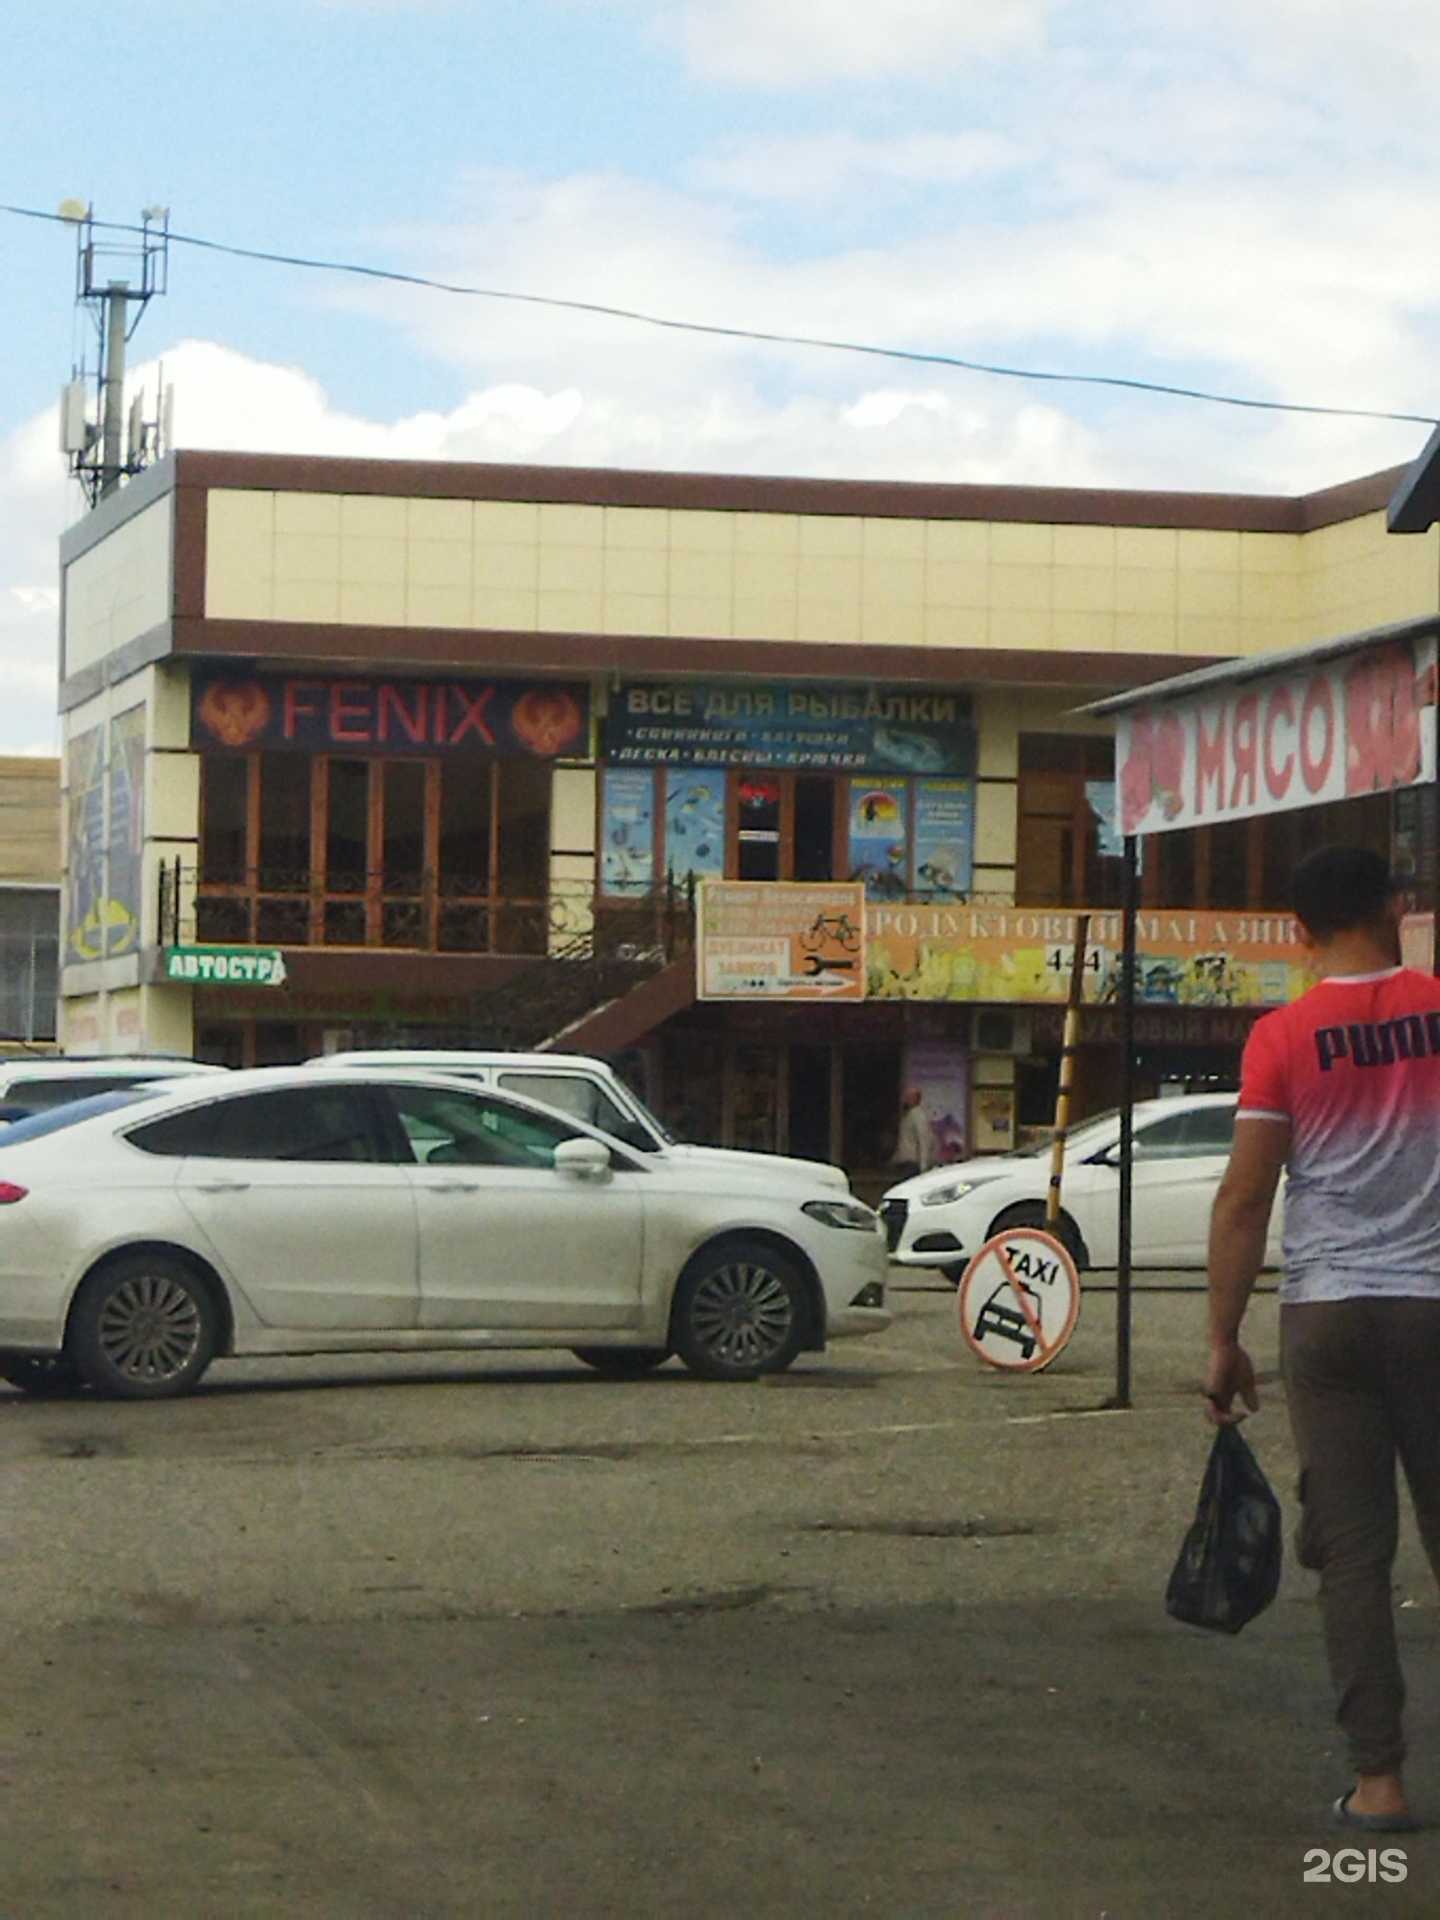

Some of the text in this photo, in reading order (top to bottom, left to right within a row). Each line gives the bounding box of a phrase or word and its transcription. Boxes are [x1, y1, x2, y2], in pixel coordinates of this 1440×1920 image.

[282, 681, 498, 745] FENIX
[627, 687, 956, 723] ВСЕ ДЛЯ РЫБАЛКИ
[1194, 674, 1335, 816] МЯСО
[1045, 948, 1101, 973] 44
[1004, 1246, 1060, 1287] TAXI
